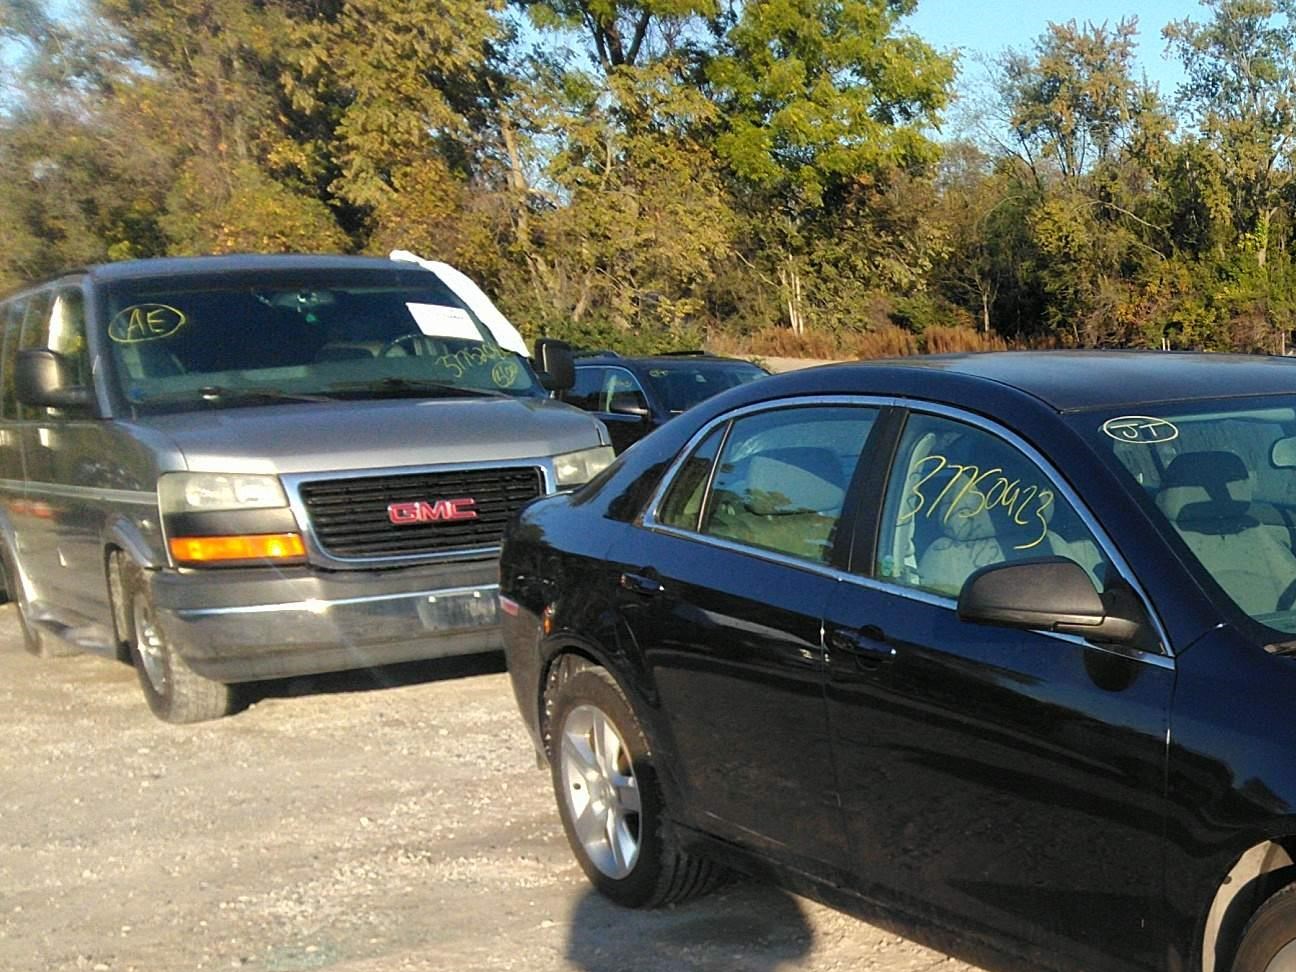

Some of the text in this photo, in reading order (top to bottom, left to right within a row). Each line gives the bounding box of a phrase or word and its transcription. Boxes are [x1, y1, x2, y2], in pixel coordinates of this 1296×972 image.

[127, 308, 166, 341] AE
[387, 497, 479, 525] GMC
[896, 455, 1055, 550] 37750923
